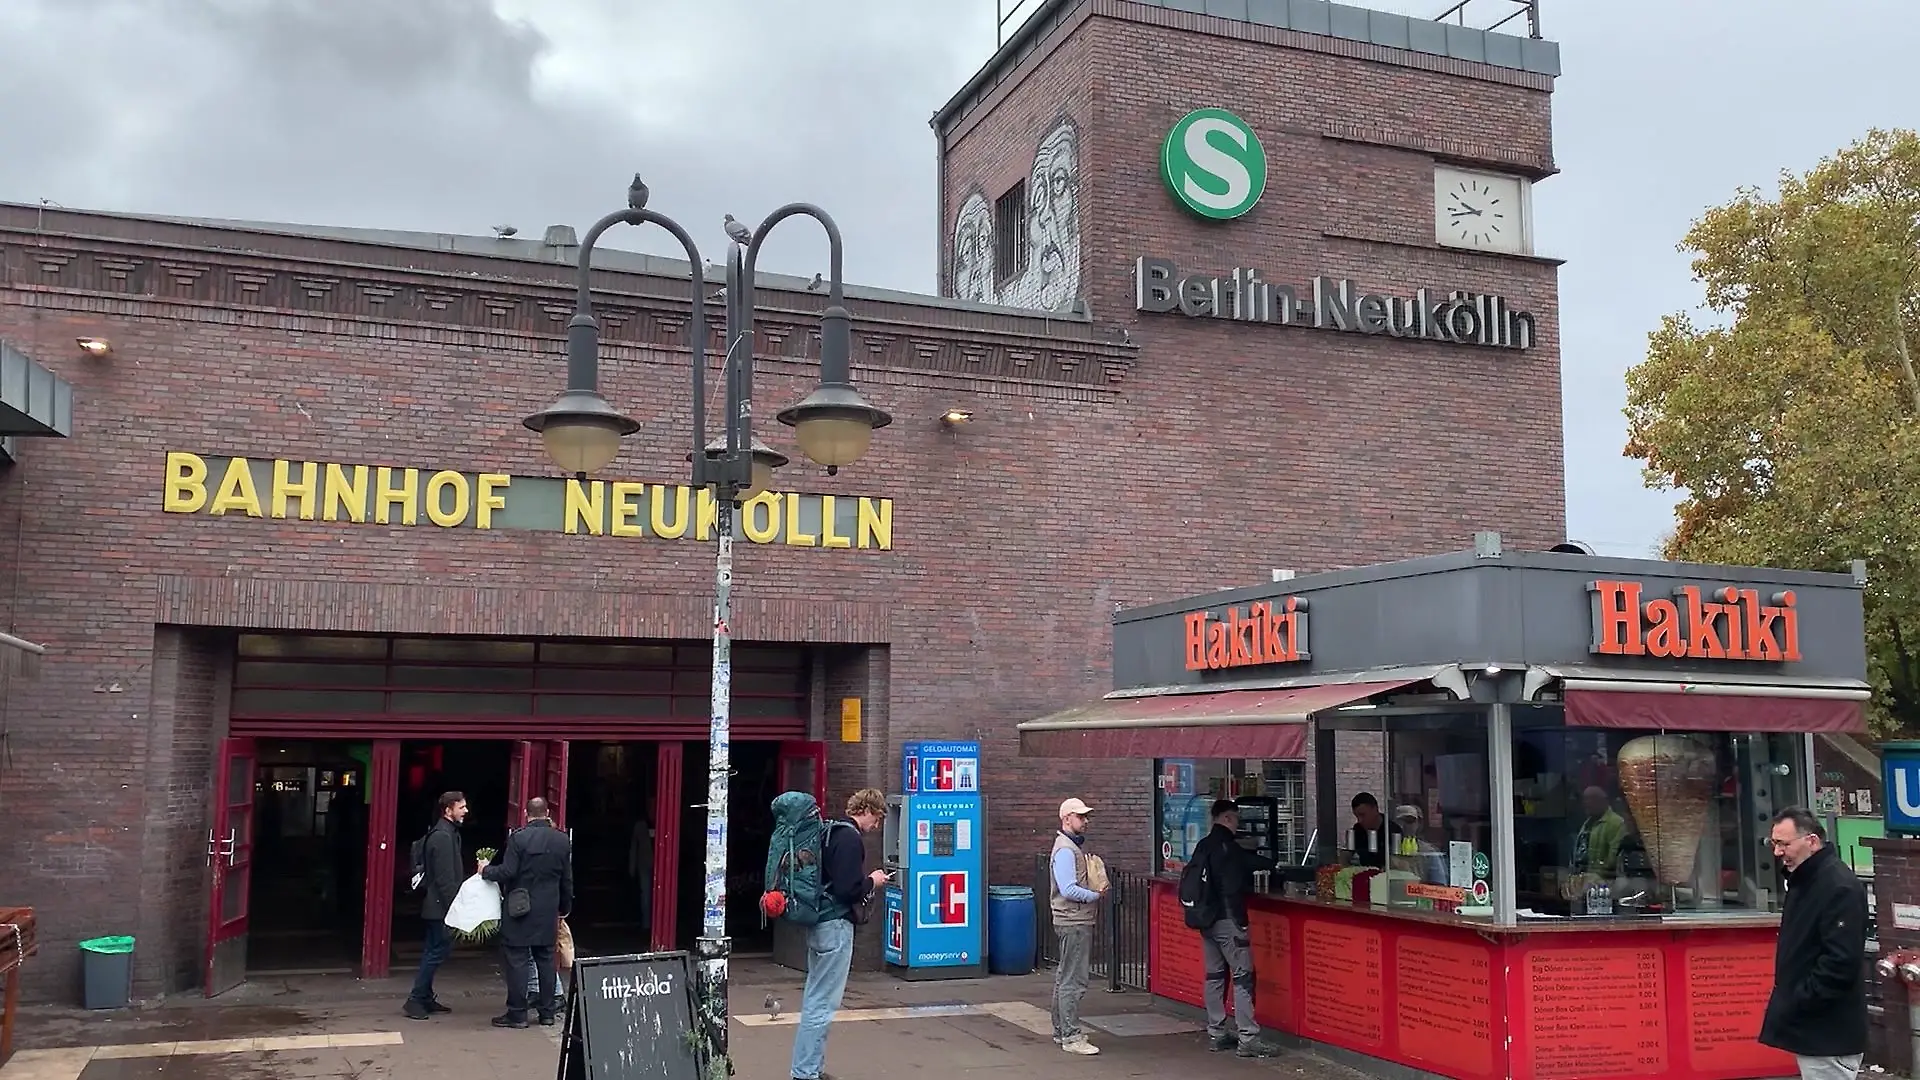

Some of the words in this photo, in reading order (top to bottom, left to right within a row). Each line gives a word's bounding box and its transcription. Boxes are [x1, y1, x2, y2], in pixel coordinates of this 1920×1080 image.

[1184, 117, 1251, 210] S
[1134, 255, 1536, 350] Berlin-Neukölln
[163, 451, 511, 530] BAHNHOF
[1184, 593, 1302, 673] Hakiki
[1596, 579, 1804, 662] Hakiki
[923, 745, 977, 753] GELDAUTOMAT
[1894, 768, 1920, 817] U
[601, 974, 671, 999] fritz-kola
[919, 952, 961, 961] moneyserv
